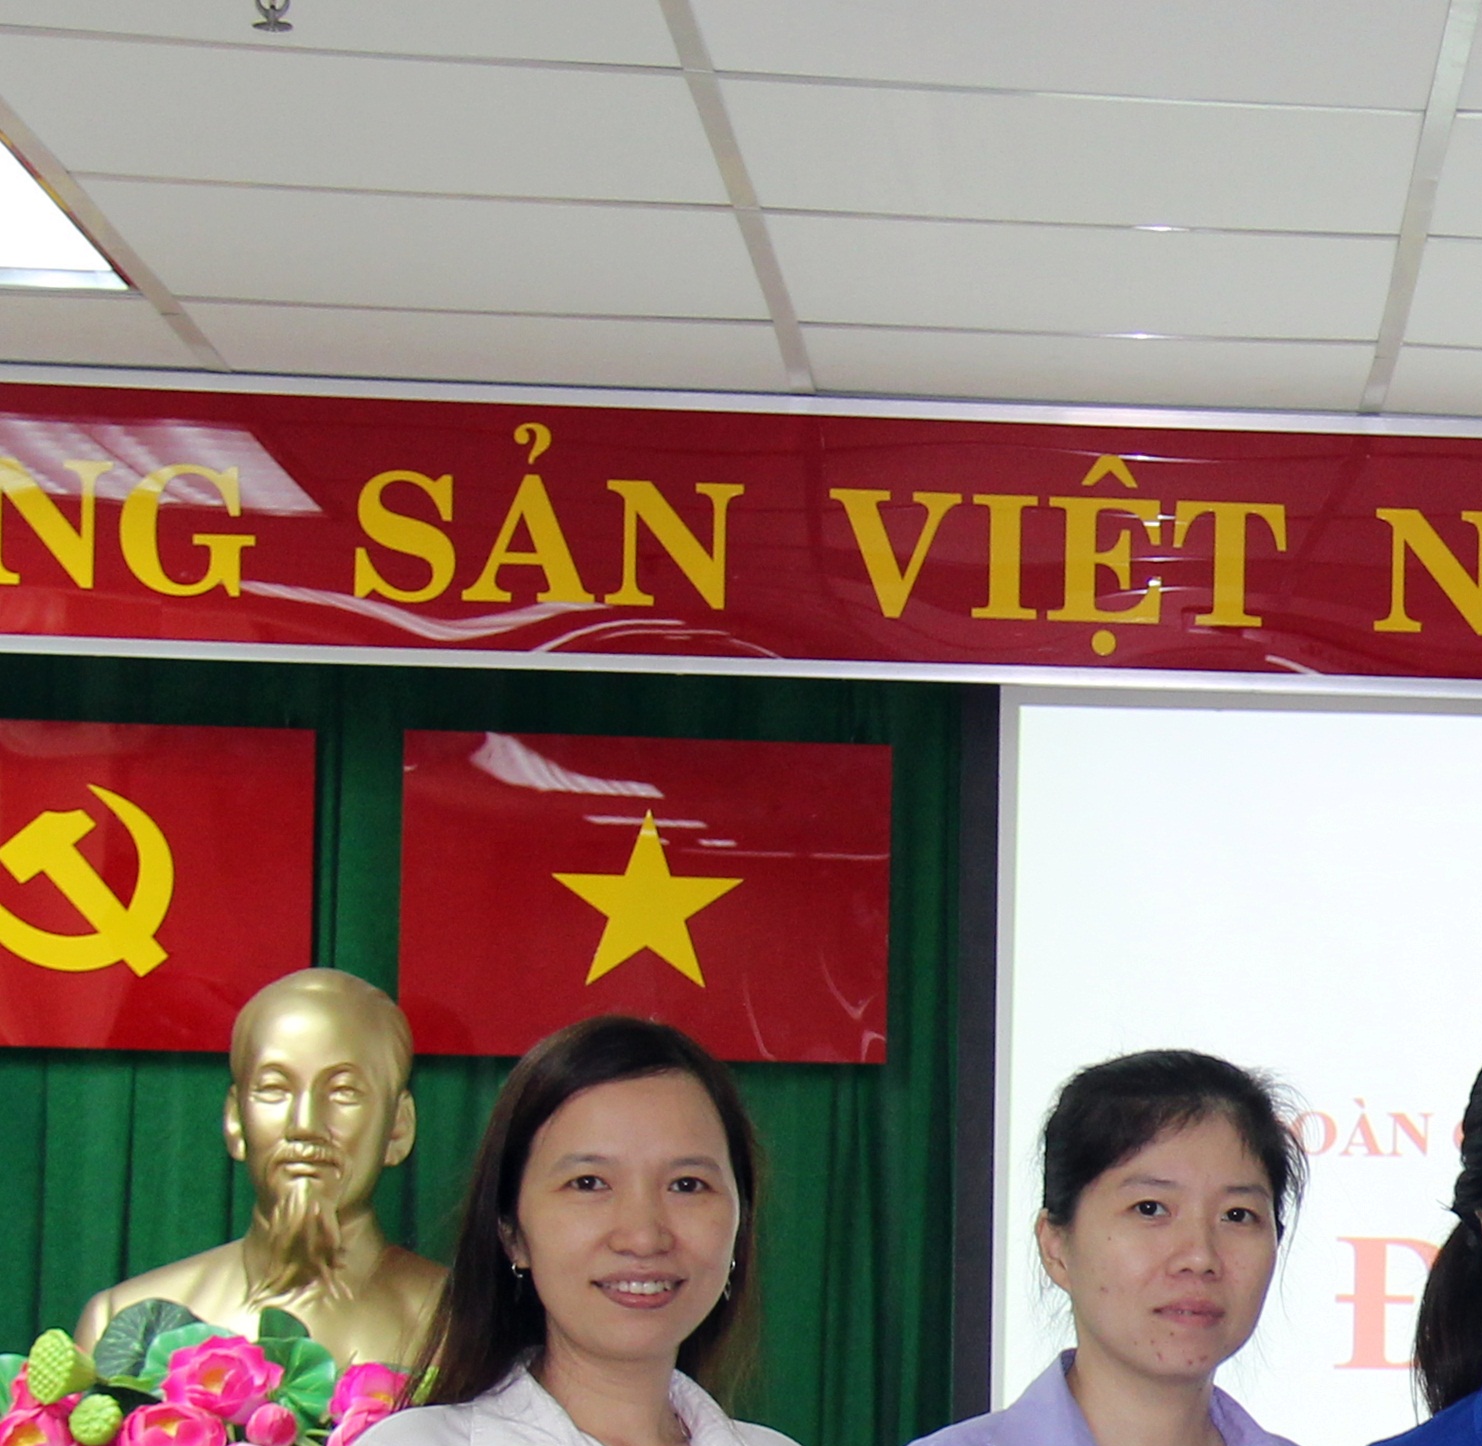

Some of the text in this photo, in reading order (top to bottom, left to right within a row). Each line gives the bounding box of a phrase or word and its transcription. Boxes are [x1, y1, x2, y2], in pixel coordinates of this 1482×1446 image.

[0, 457, 256, 598] NG
[353, 421, 745, 612] SẢN
[828, 453, 1287, 657] VIỆT
[1288, 1098, 1433, 1157] OÀN
